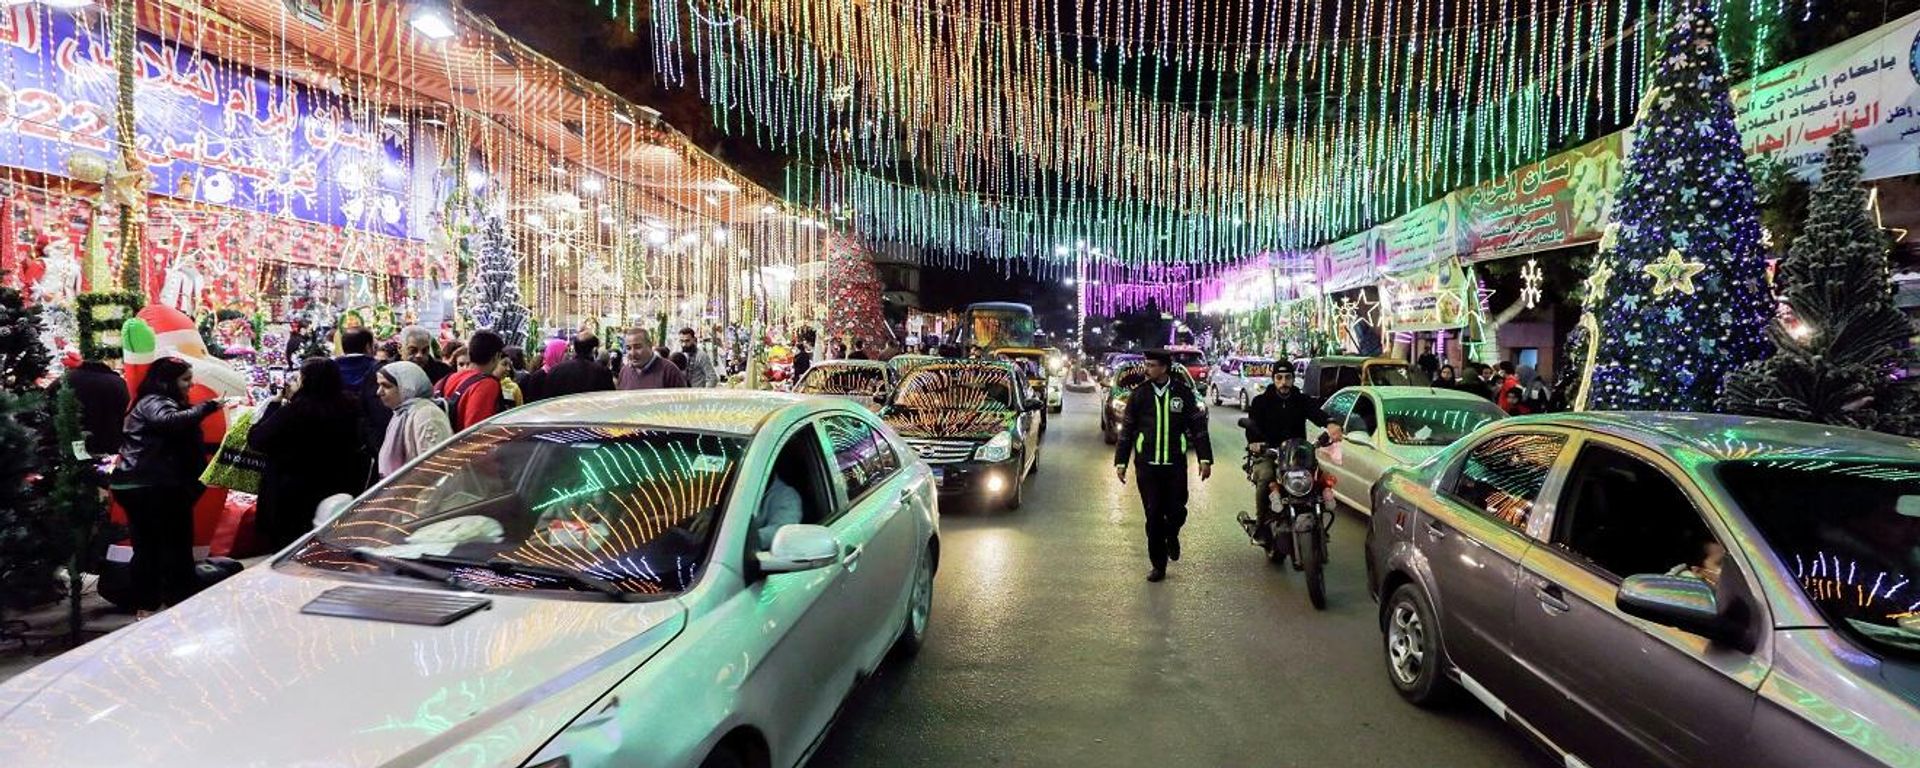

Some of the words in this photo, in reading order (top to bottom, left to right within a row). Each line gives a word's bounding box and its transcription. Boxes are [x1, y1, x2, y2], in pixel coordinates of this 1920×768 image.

[0, 3, 40, 53] ال
[1833, 56, 1897, 88] بالعام
[1789, 90, 1858, 119] وبأعياد
[1886, 105, 1913, 124] وطن
[1740, 110, 1785, 134] الميلاد
[1521, 159, 1571, 195] سان
